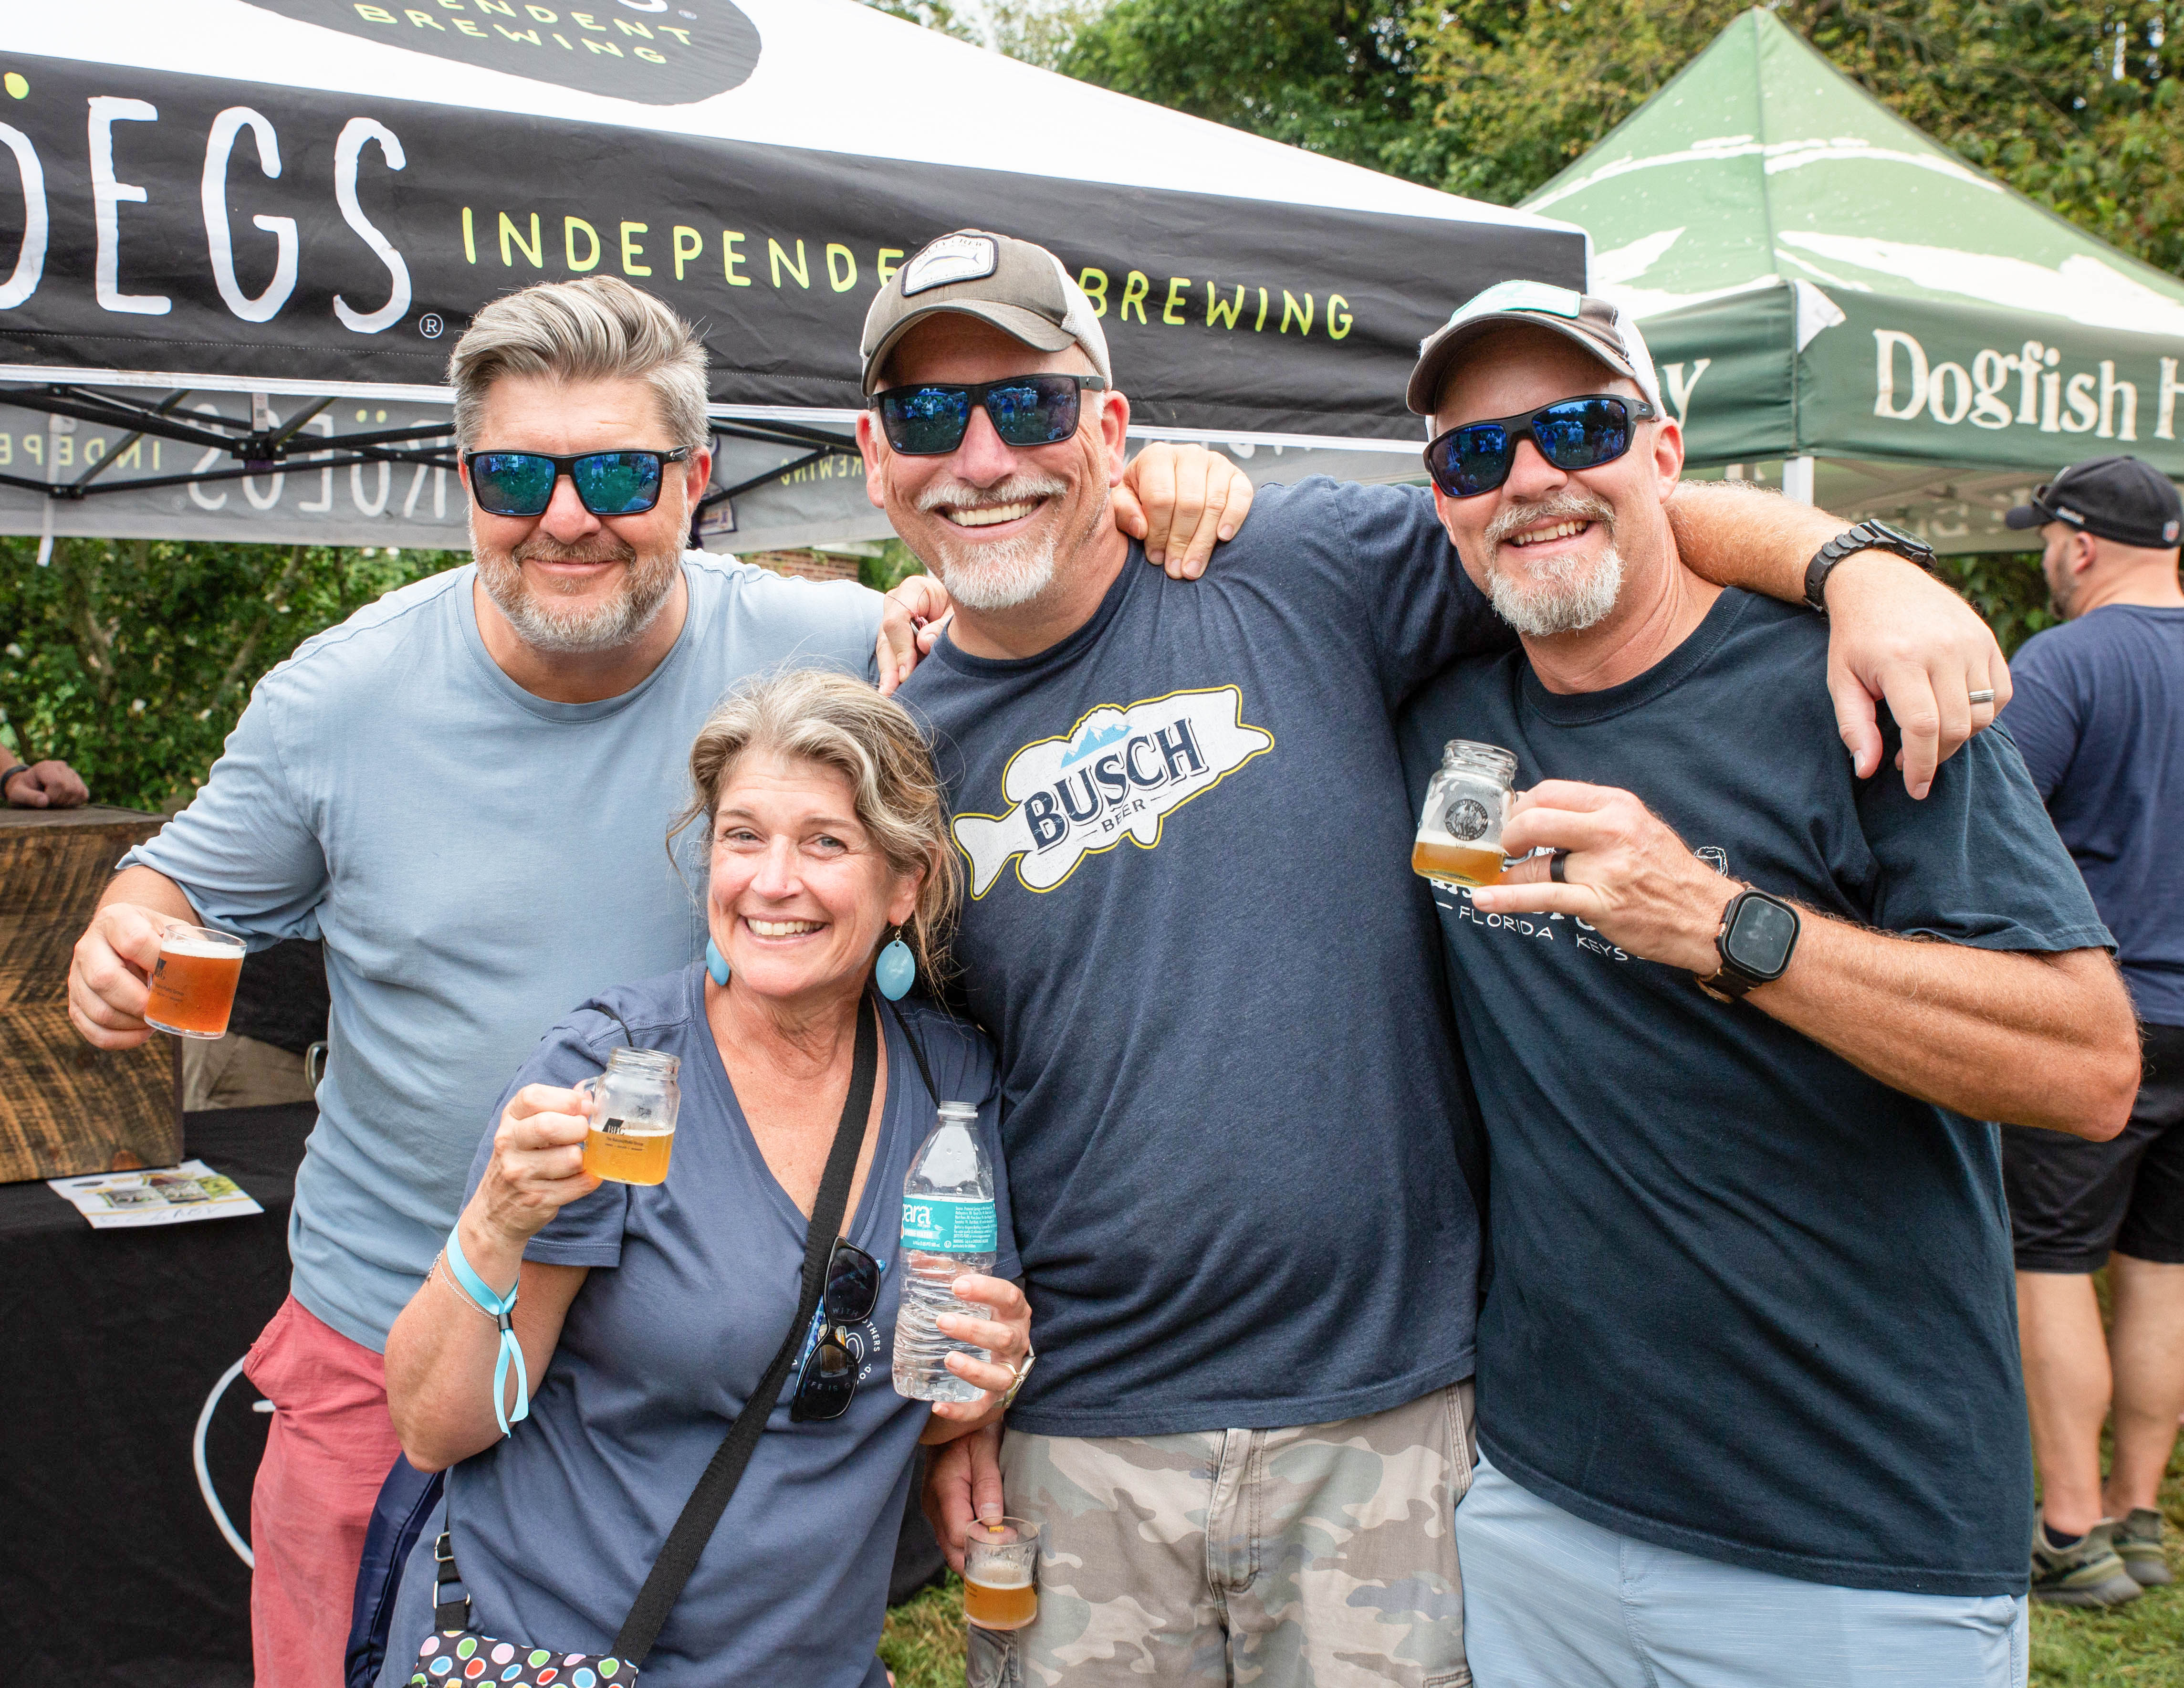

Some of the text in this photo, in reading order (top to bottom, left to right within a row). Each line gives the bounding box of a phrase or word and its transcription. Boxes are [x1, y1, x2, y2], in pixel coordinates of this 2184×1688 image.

[354, 3, 667, 64] BREWING
[461, 206, 1353, 340] INDEPENDE BREWING
[1872, 328, 2138, 441] Dogfish
[1024, 714, 1209, 855] BUSCH
[1101, 798, 1146, 833] BEER
[1455, 841, 1466, 849] VIP
[1459, 905, 1553, 940] FLORIDA
[1576, 933, 1629, 961] KEYS
[844, 1366, 871, 1389] GOD
